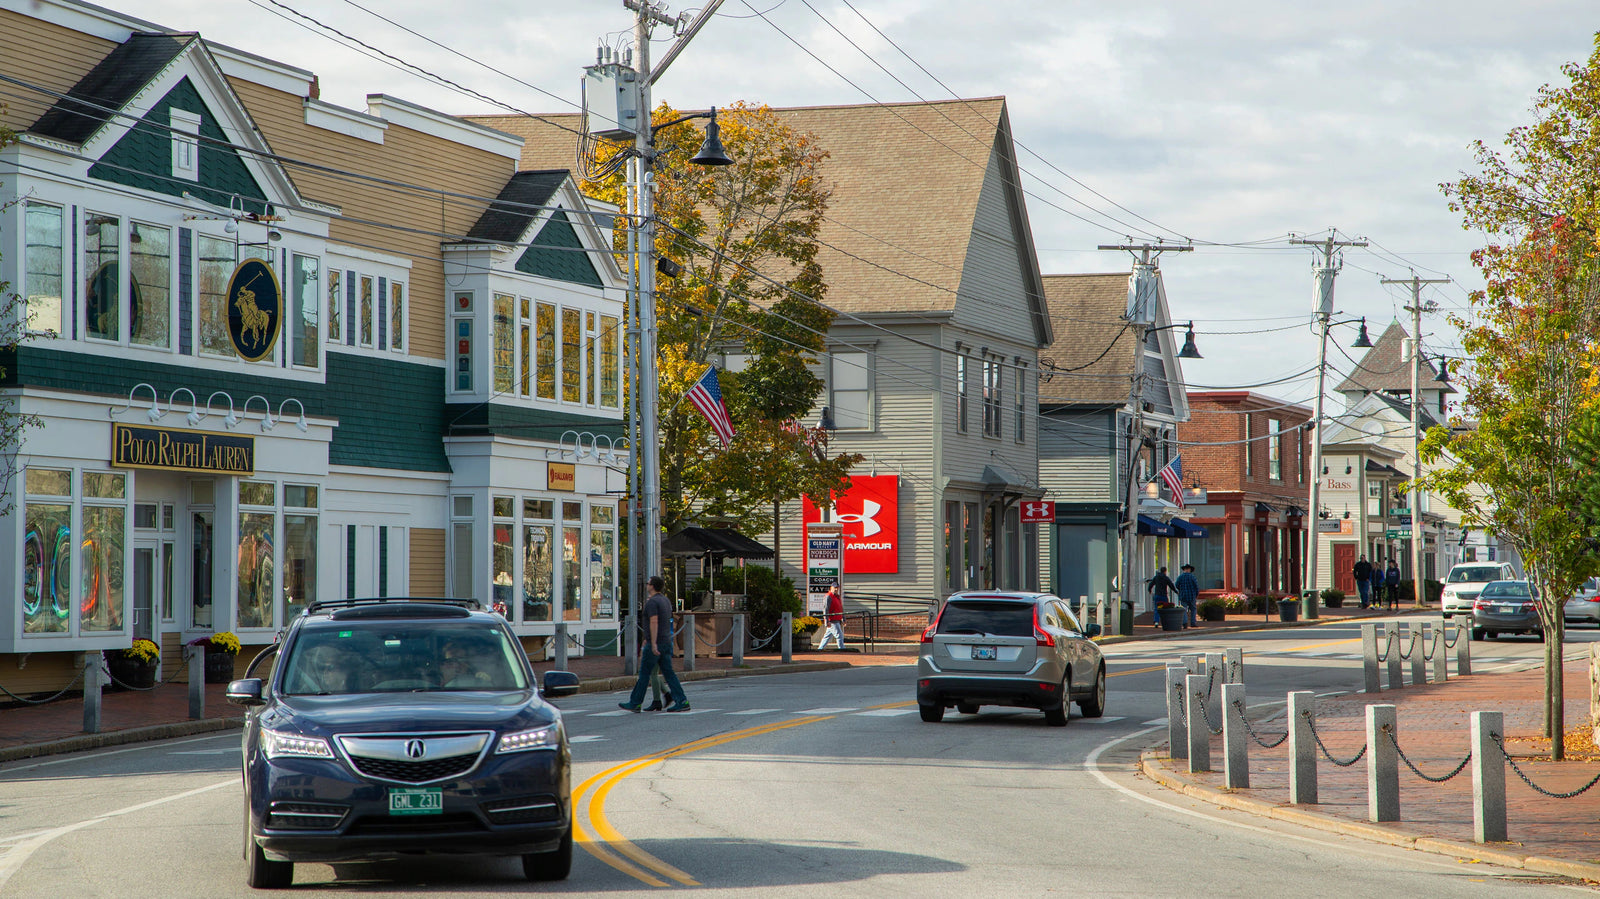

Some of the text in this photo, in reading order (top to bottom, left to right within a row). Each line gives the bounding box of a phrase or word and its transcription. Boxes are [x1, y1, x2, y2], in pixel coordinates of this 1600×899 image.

[120, 428, 250, 471] POLO RALPH LAUREN
[1327, 478, 1352, 489] Bass
[420, 794, 438, 808] 231
